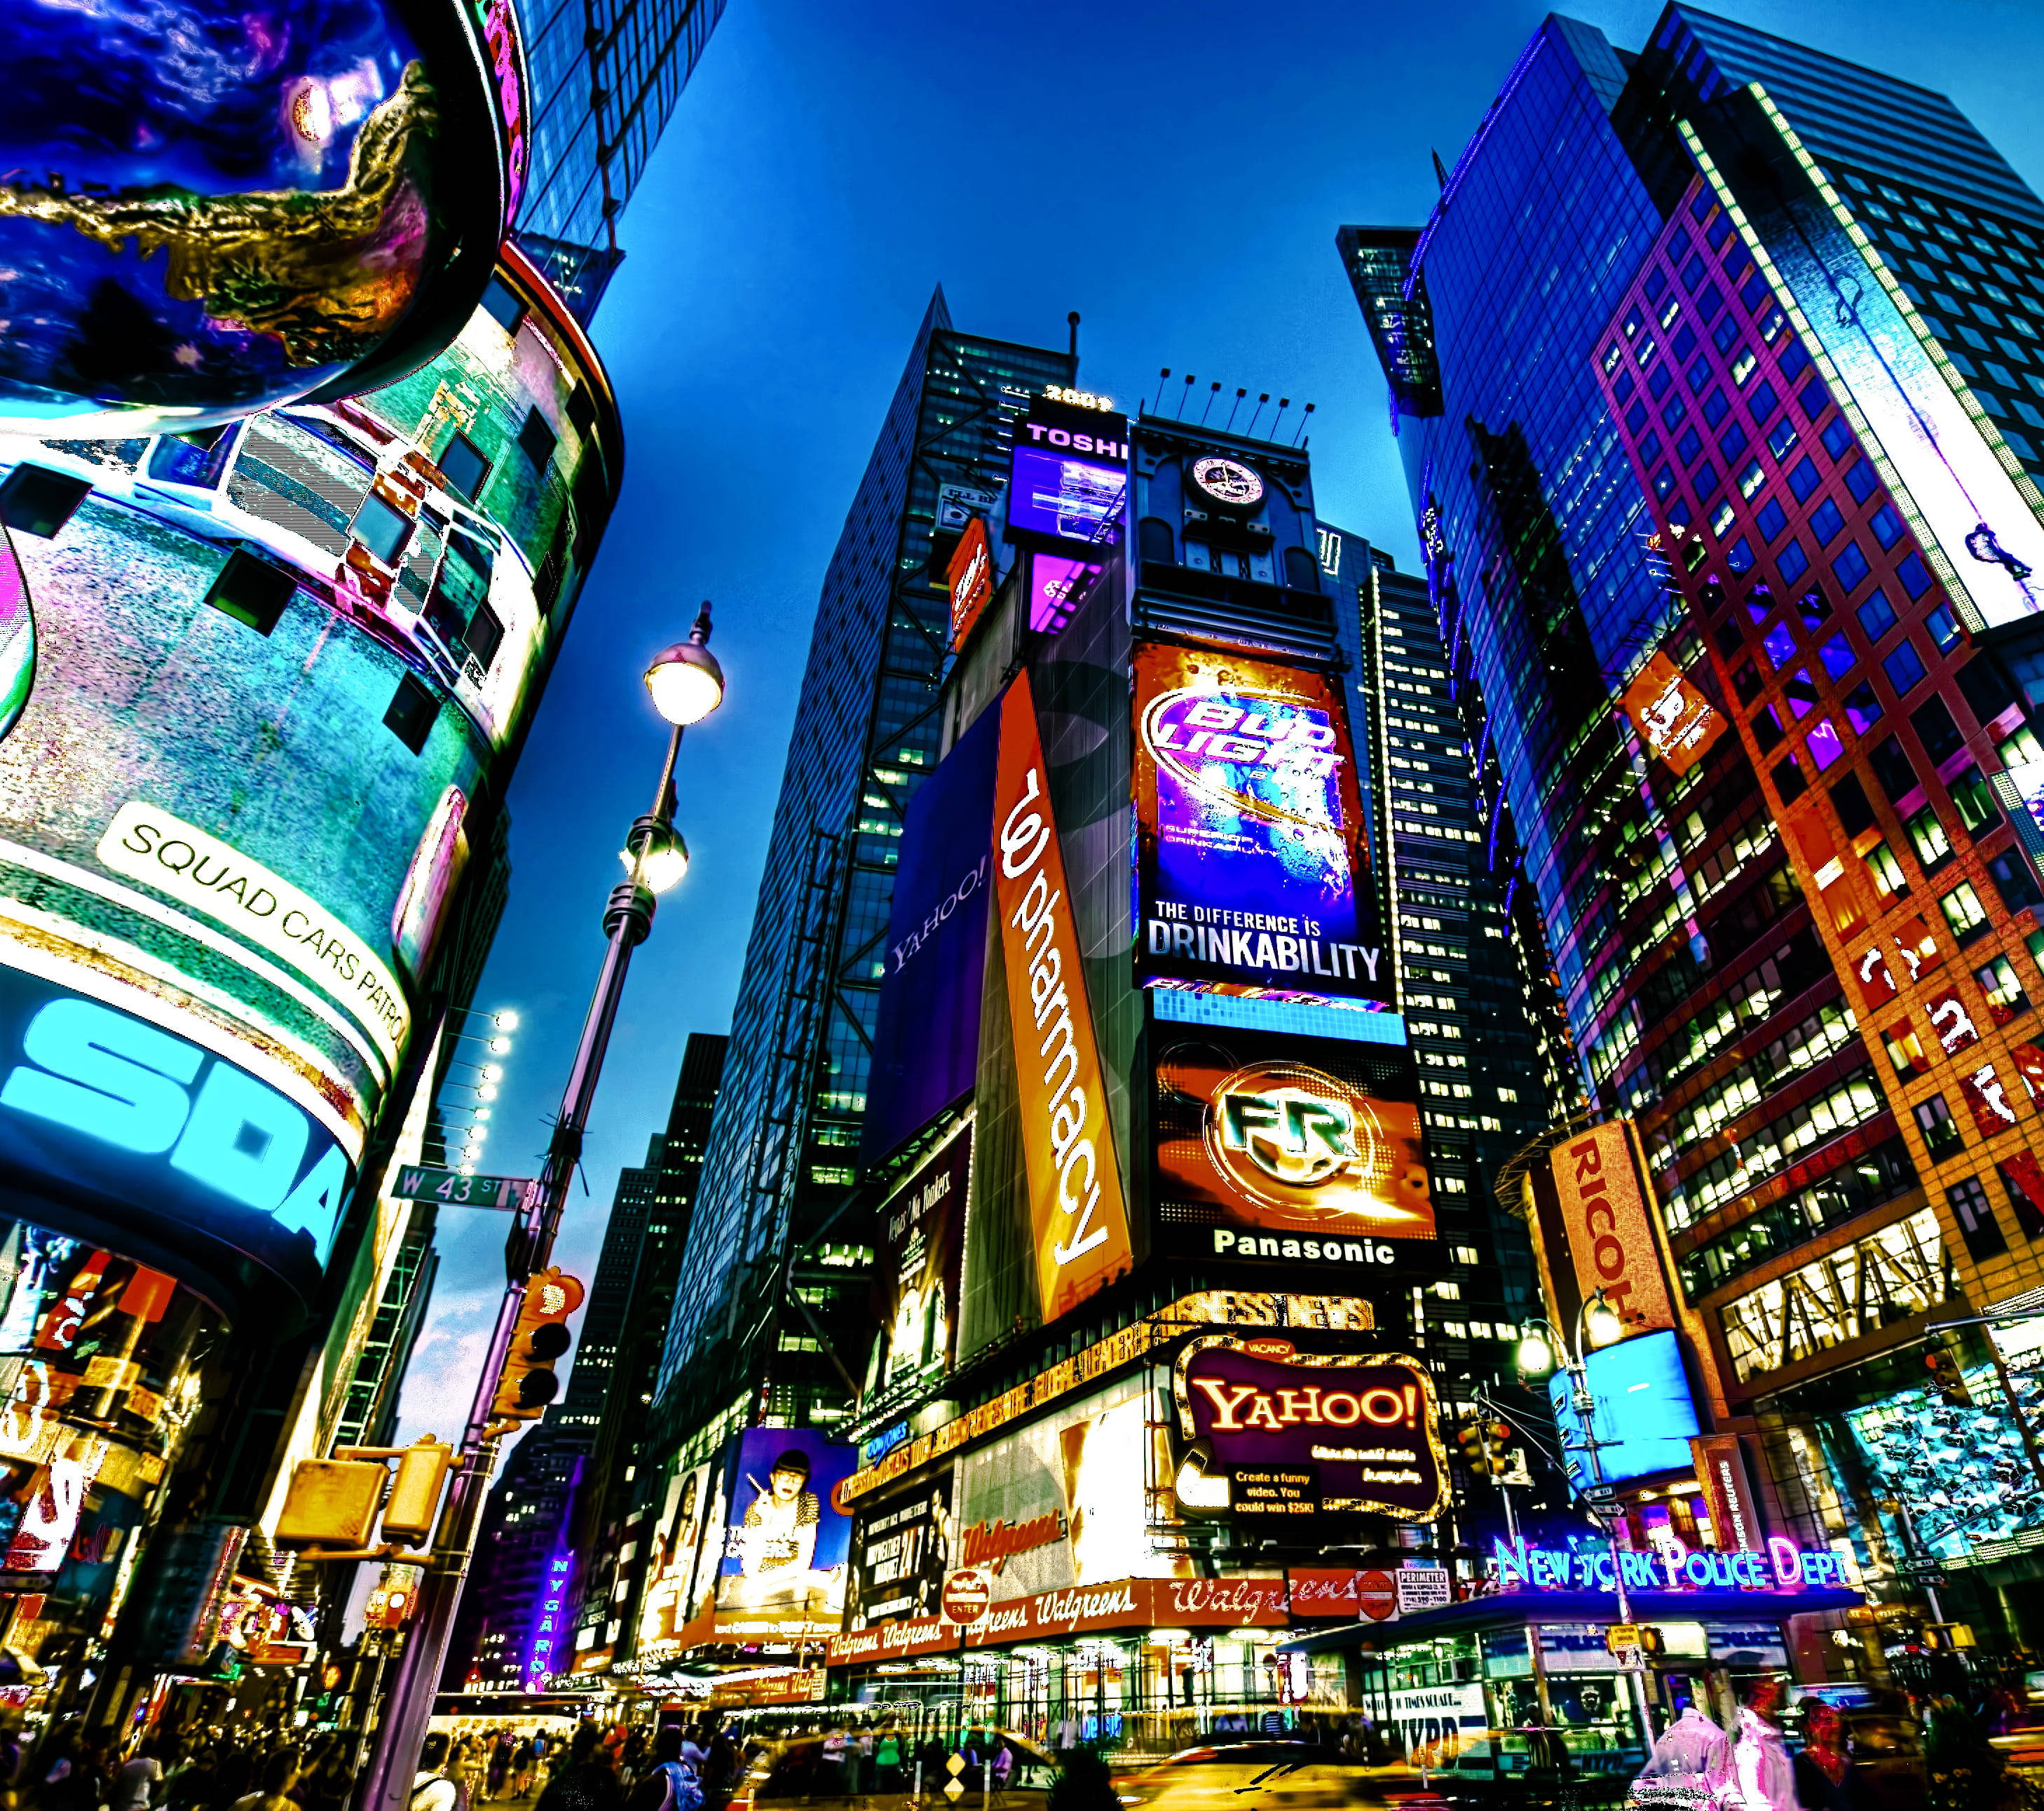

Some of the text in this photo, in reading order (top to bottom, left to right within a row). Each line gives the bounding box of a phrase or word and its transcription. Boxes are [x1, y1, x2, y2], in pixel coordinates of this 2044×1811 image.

[1183, 699, 1336, 748] BUD
[122, 824, 278, 918] SQUAD
[282, 910, 359, 980] CARS
[893, 855, 988, 975] YAHOO!
[1155, 901, 1187, 920] THE
[1194, 905, 1300, 935] DIFFERENCE
[1148, 918, 1379, 982] DRINKABILITY
[1011, 867, 1109, 1266] pharmacy
[402, 1170, 503, 1202] W 43 ST
[1213, 1229, 1396, 1264] Panasonic
[1248, 1343, 1290, 1354] VACANCY
[1192, 1378, 1415, 1432] YAHOO!
[1235, 1471, 1271, 1483] Create
[1281, 1473, 1310, 1485] funny
[1247, 1486, 1300, 1498] video. You
[1235, 1502, 1265, 1512] could
[1267, 1503, 1286, 1512] win
[1401, 1571, 1446, 1583] PERIMETER
[1494, 1535, 1847, 1586] NEW YORK POLICE DEPT
[831, 1633, 878, 1663] Walgreens
[883, 1621, 943, 1655] Walgreens
[953, 1604, 1028, 1645] greens
[1035, 1586, 1138, 1632] Walgreens
[1169, 1578, 1358, 1625] Walgreens
[953, 1604, 979, 1613] ENTER
[1404, 1694, 1425, 1709] TIMES
